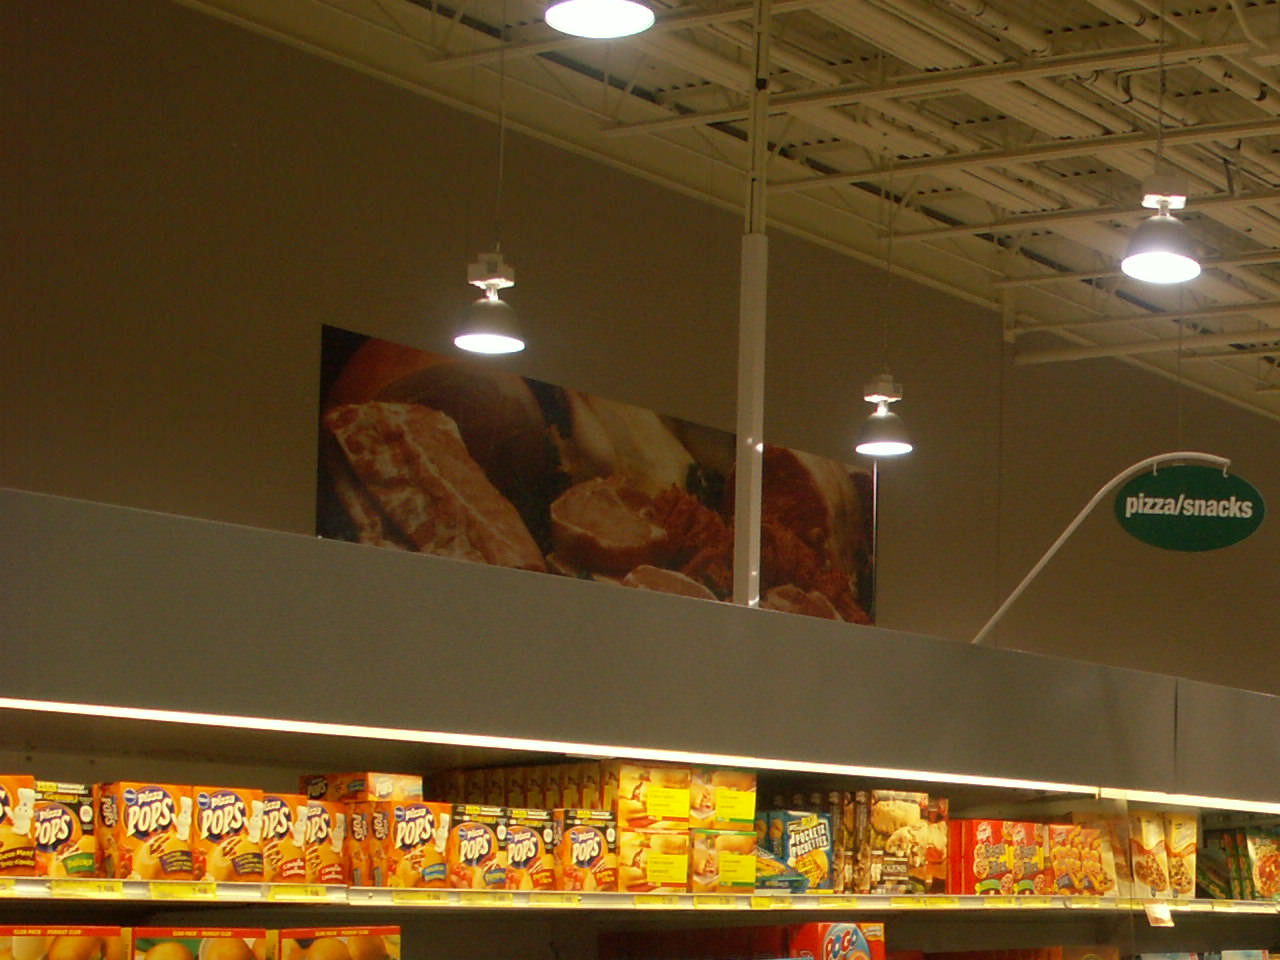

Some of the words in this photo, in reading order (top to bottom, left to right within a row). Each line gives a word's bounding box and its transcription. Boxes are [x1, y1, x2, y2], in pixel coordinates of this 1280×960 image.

[1125, 493, 1254, 518] pizza/snacks
[127, 800, 172, 837] POPS
[201, 804, 246, 840] POPS
[396, 816, 433, 849] POPS
[461, 834, 491, 863] POPS
[508, 837, 537, 865] POPS
[573, 837, 601, 865] POPS
